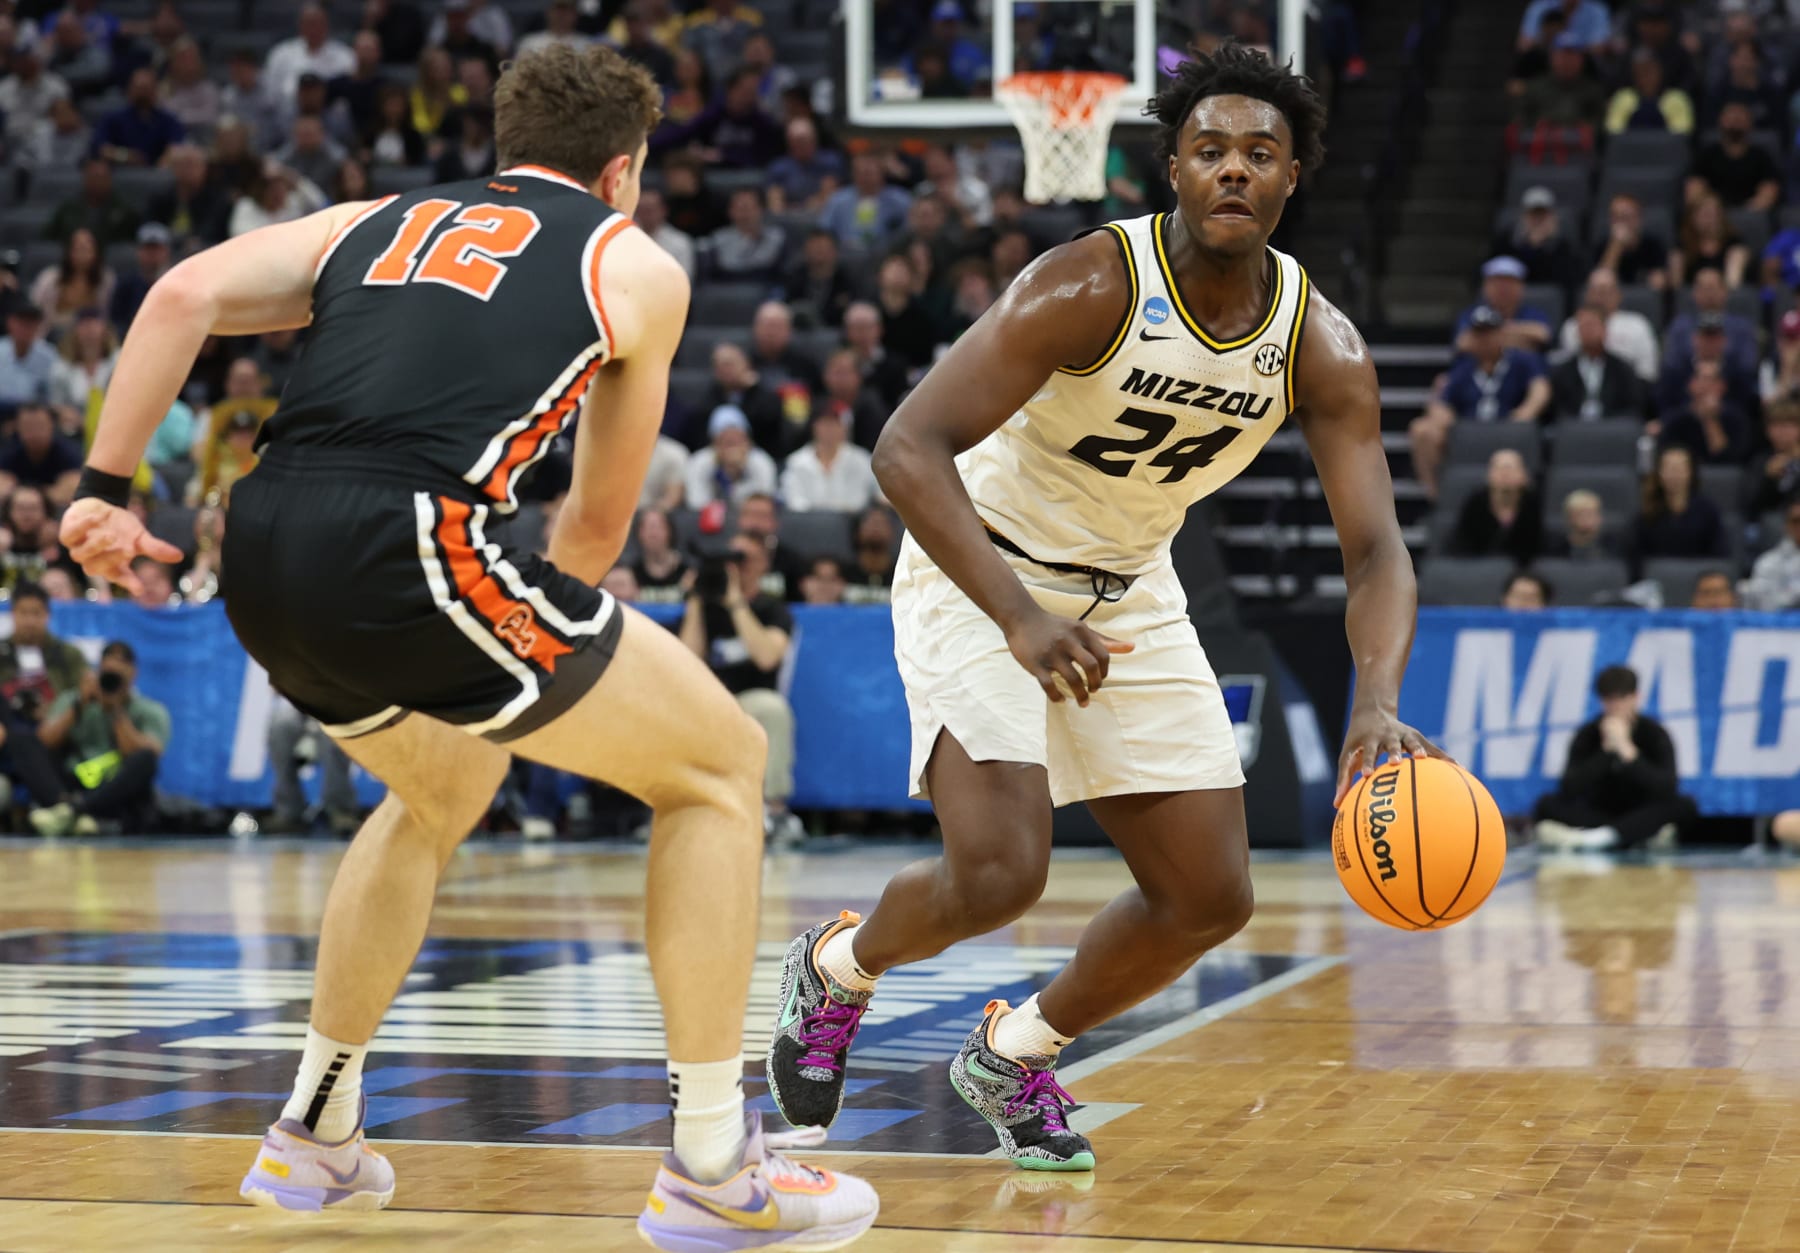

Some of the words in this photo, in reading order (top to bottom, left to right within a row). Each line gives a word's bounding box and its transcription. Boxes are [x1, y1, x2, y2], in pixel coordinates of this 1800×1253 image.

[362, 198, 542, 302] 12
[1145, 307, 1168, 320] NCAA
[1119, 367, 1273, 420] MIZZOU
[1255, 344, 1284, 375] SEC
[1068, 407, 1243, 484] 24
[1440, 629, 1800, 778] MAD
[1369, 770, 1400, 882] Wilson
